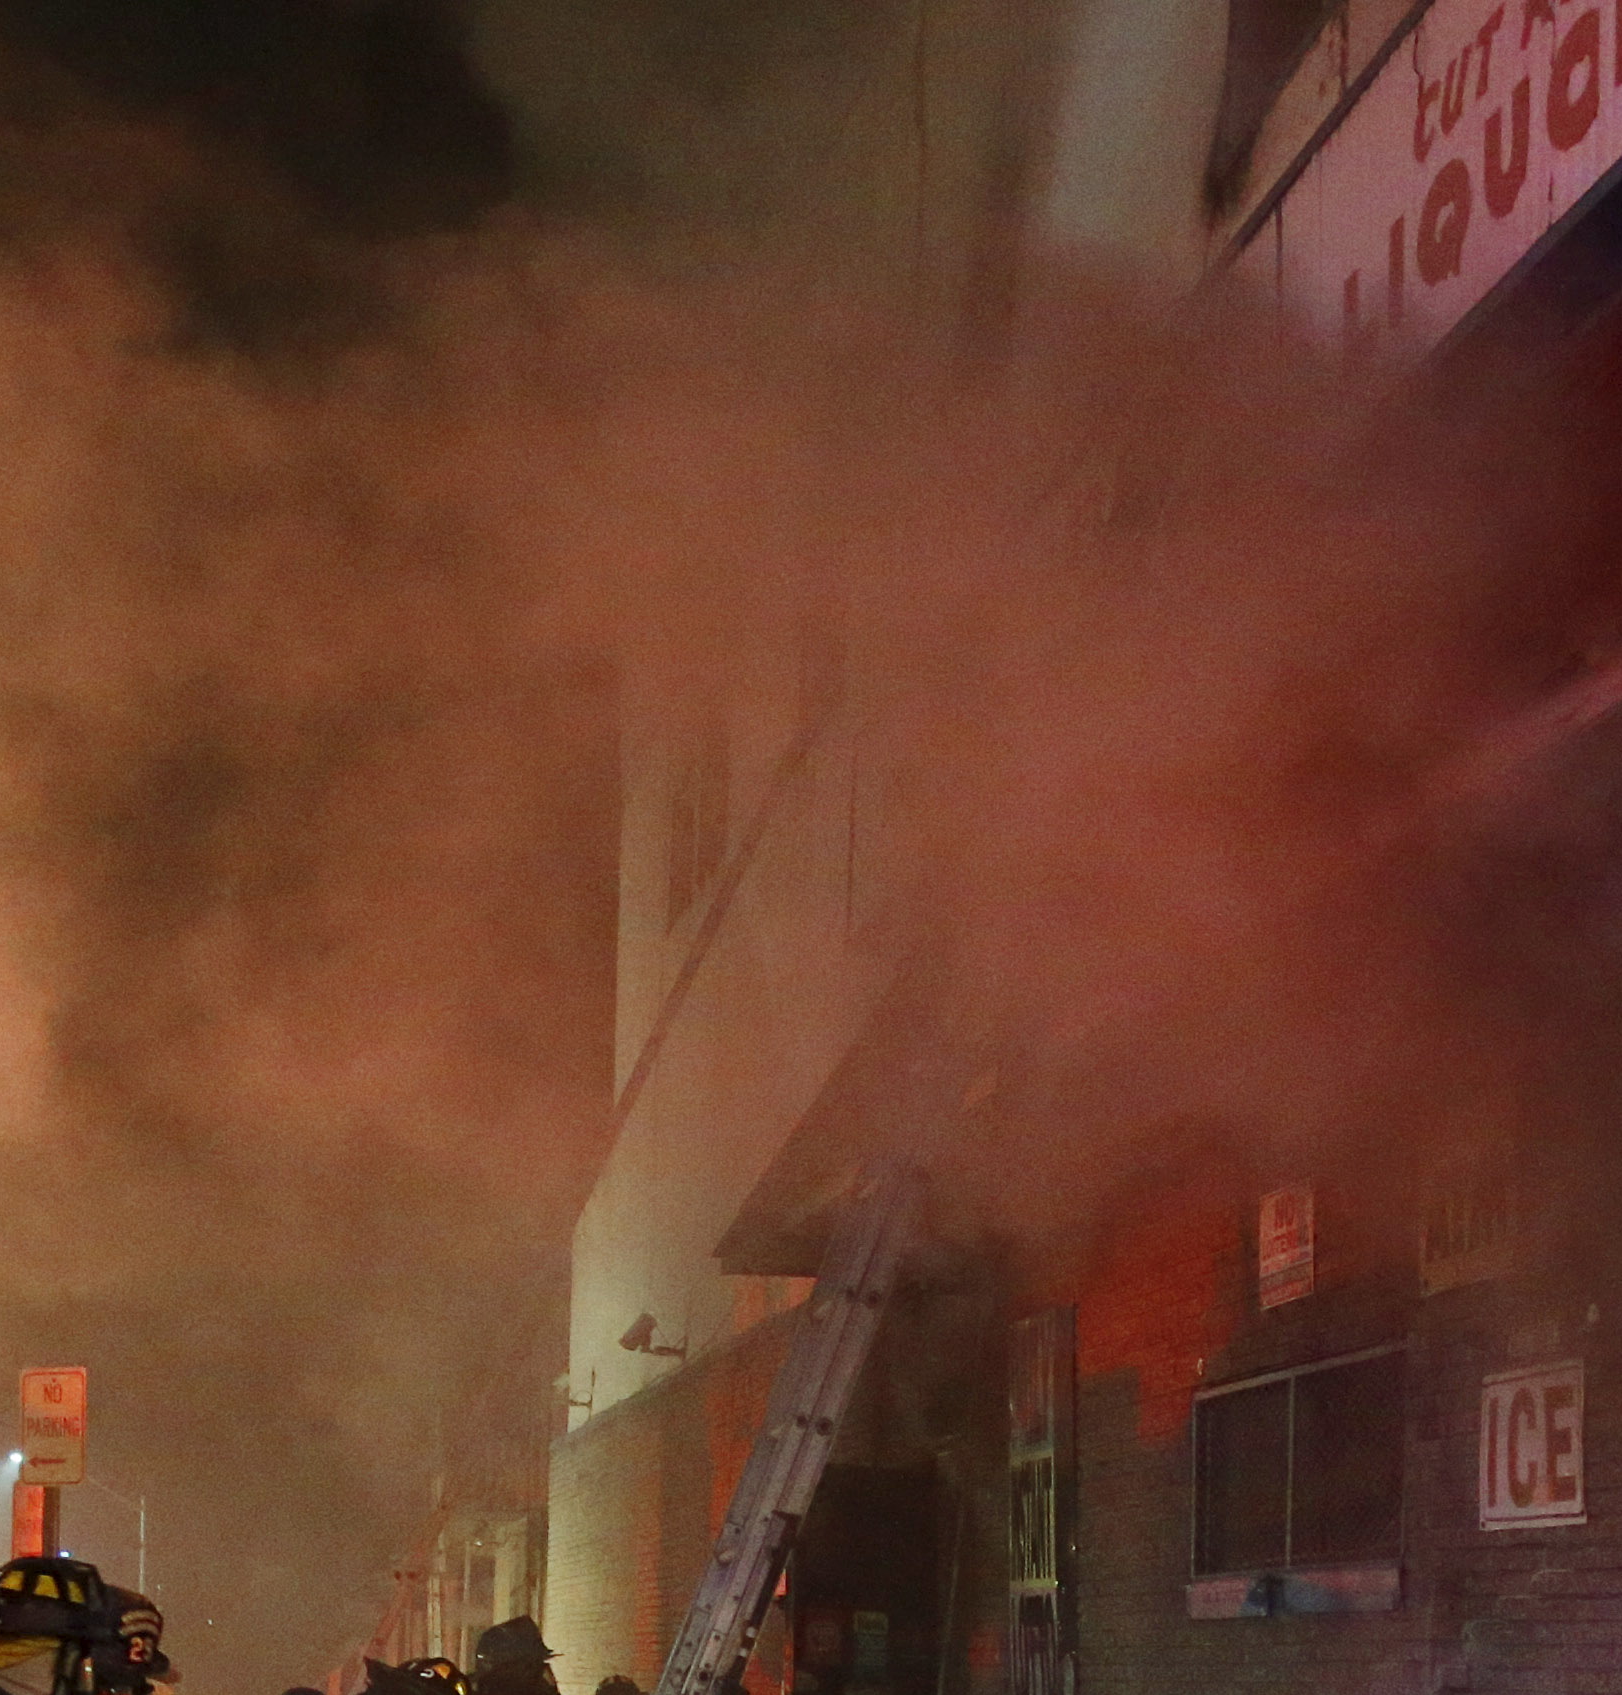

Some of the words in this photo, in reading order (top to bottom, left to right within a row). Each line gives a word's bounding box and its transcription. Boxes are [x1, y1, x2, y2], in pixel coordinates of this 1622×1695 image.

[43, 1383, 63, 1404] NO
[27, 1415, 81, 1438] PARKING
[1487, 1385, 1578, 1509] ICE
